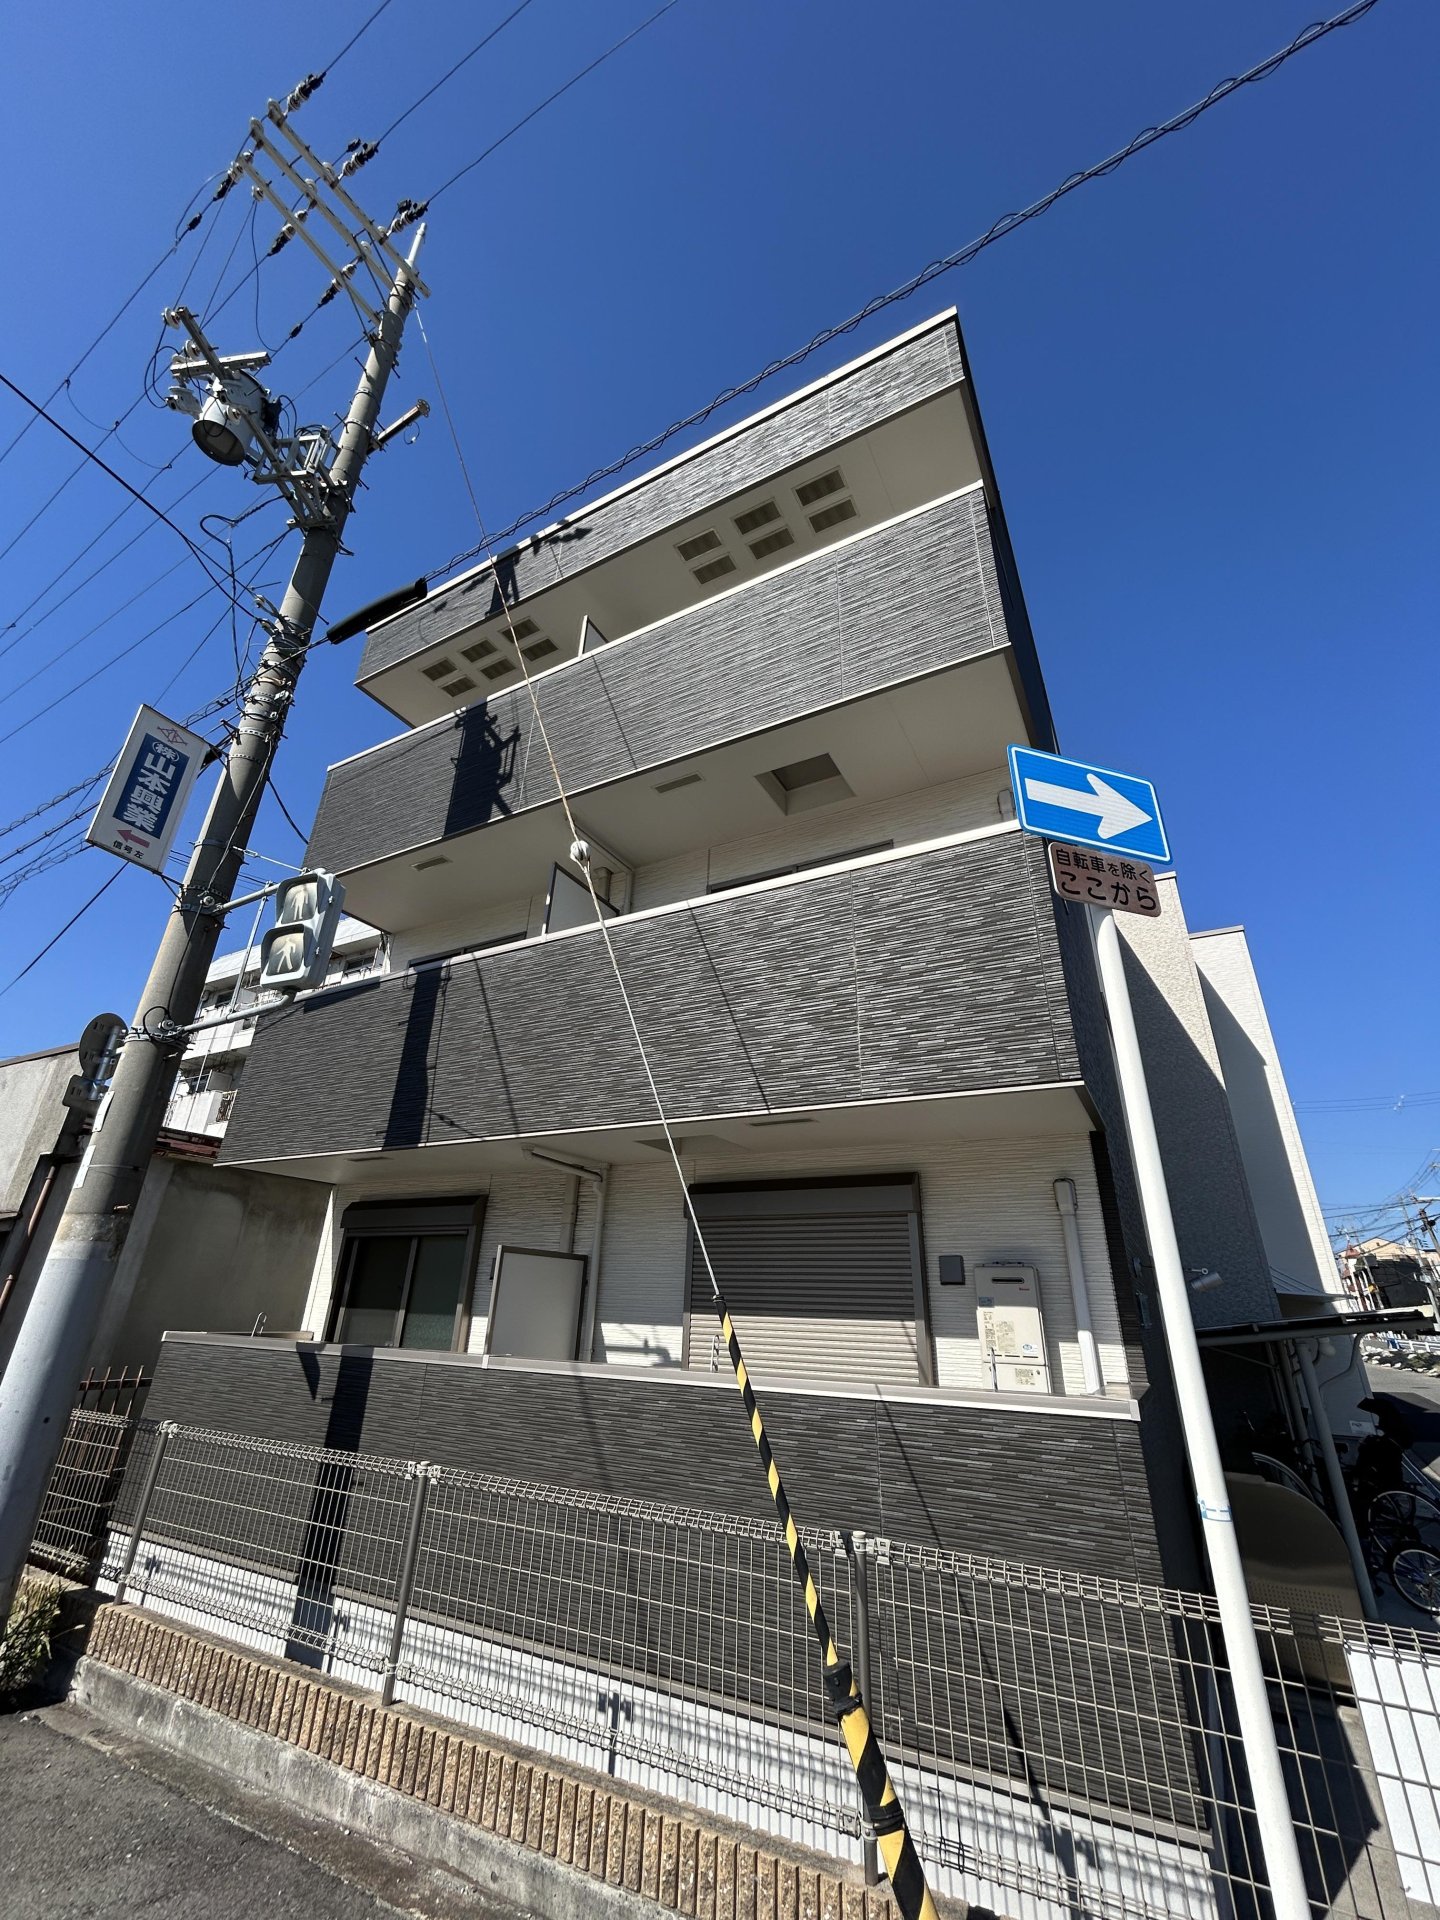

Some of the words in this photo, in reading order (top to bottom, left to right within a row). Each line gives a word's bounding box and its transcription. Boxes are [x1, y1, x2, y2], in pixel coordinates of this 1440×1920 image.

[112, 839, 145, 860] 信号左
[1056, 848, 1151, 884] 自転車を除く
[1060, 870, 1157, 911] ここから
